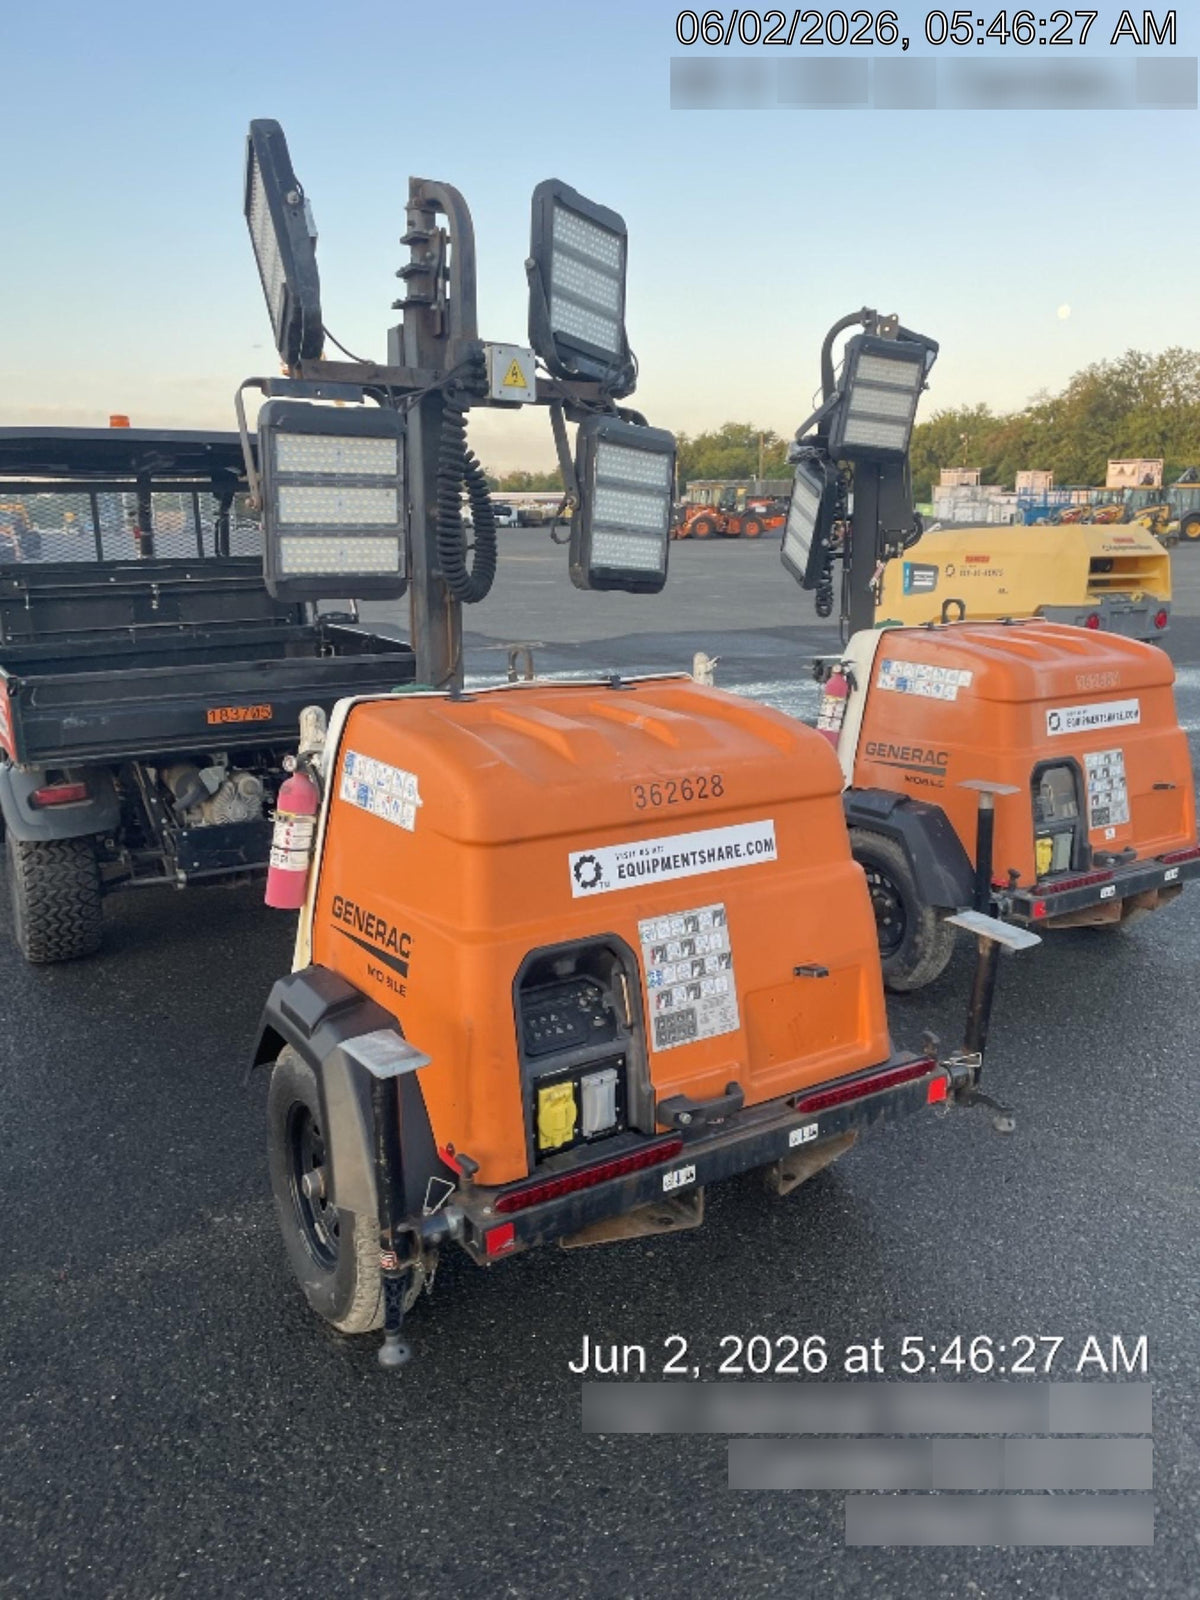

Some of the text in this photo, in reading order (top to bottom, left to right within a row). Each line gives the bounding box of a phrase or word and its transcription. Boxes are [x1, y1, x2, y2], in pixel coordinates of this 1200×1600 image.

[864, 741, 949, 766] GENERAC
[633, 774, 725, 810] 362628
[617, 837, 775, 880] EQUIPMENTSHARE.COM
[331, 894, 412, 959] GENERAC
